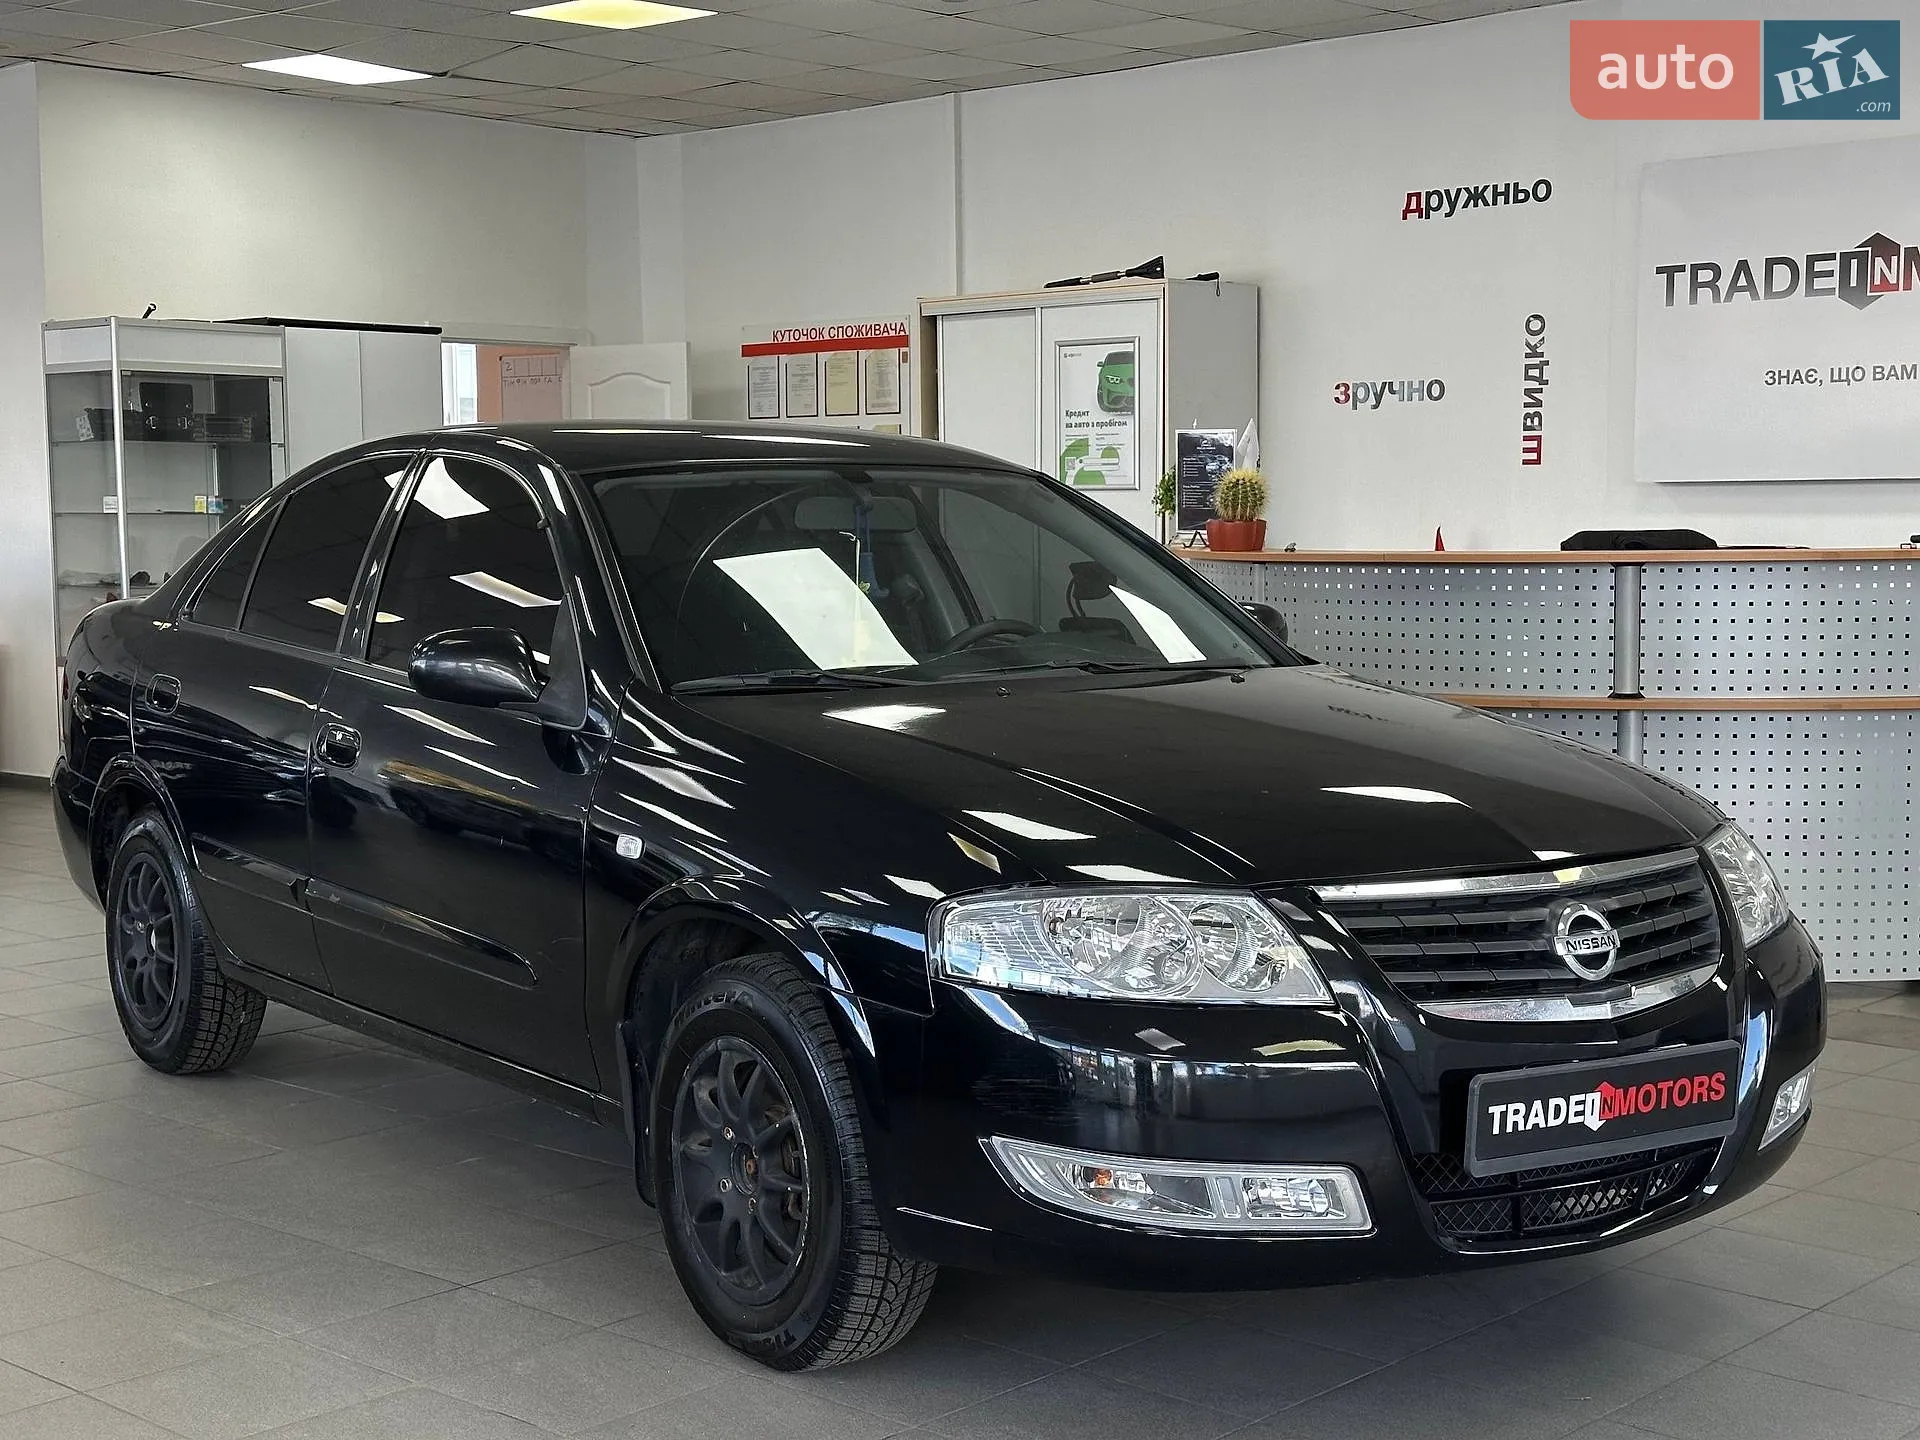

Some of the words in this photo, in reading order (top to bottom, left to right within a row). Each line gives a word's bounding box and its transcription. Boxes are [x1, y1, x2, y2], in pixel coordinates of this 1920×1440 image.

[1401, 178, 1554, 221] дружньо
[772, 327, 825, 342] КУТОЧОК
[828, 322, 907, 339] СПОЖИВАЧА
[1764, 368, 1823, 387] ЗНАЄ,
[1830, 365, 1867, 388] ЩО
[1872, 363, 1919, 382] ВАМ
[1334, 378, 1446, 411] зручно
[1065, 410, 1090, 420] Кредит
[1565, 935, 1616, 952] NISSAN
